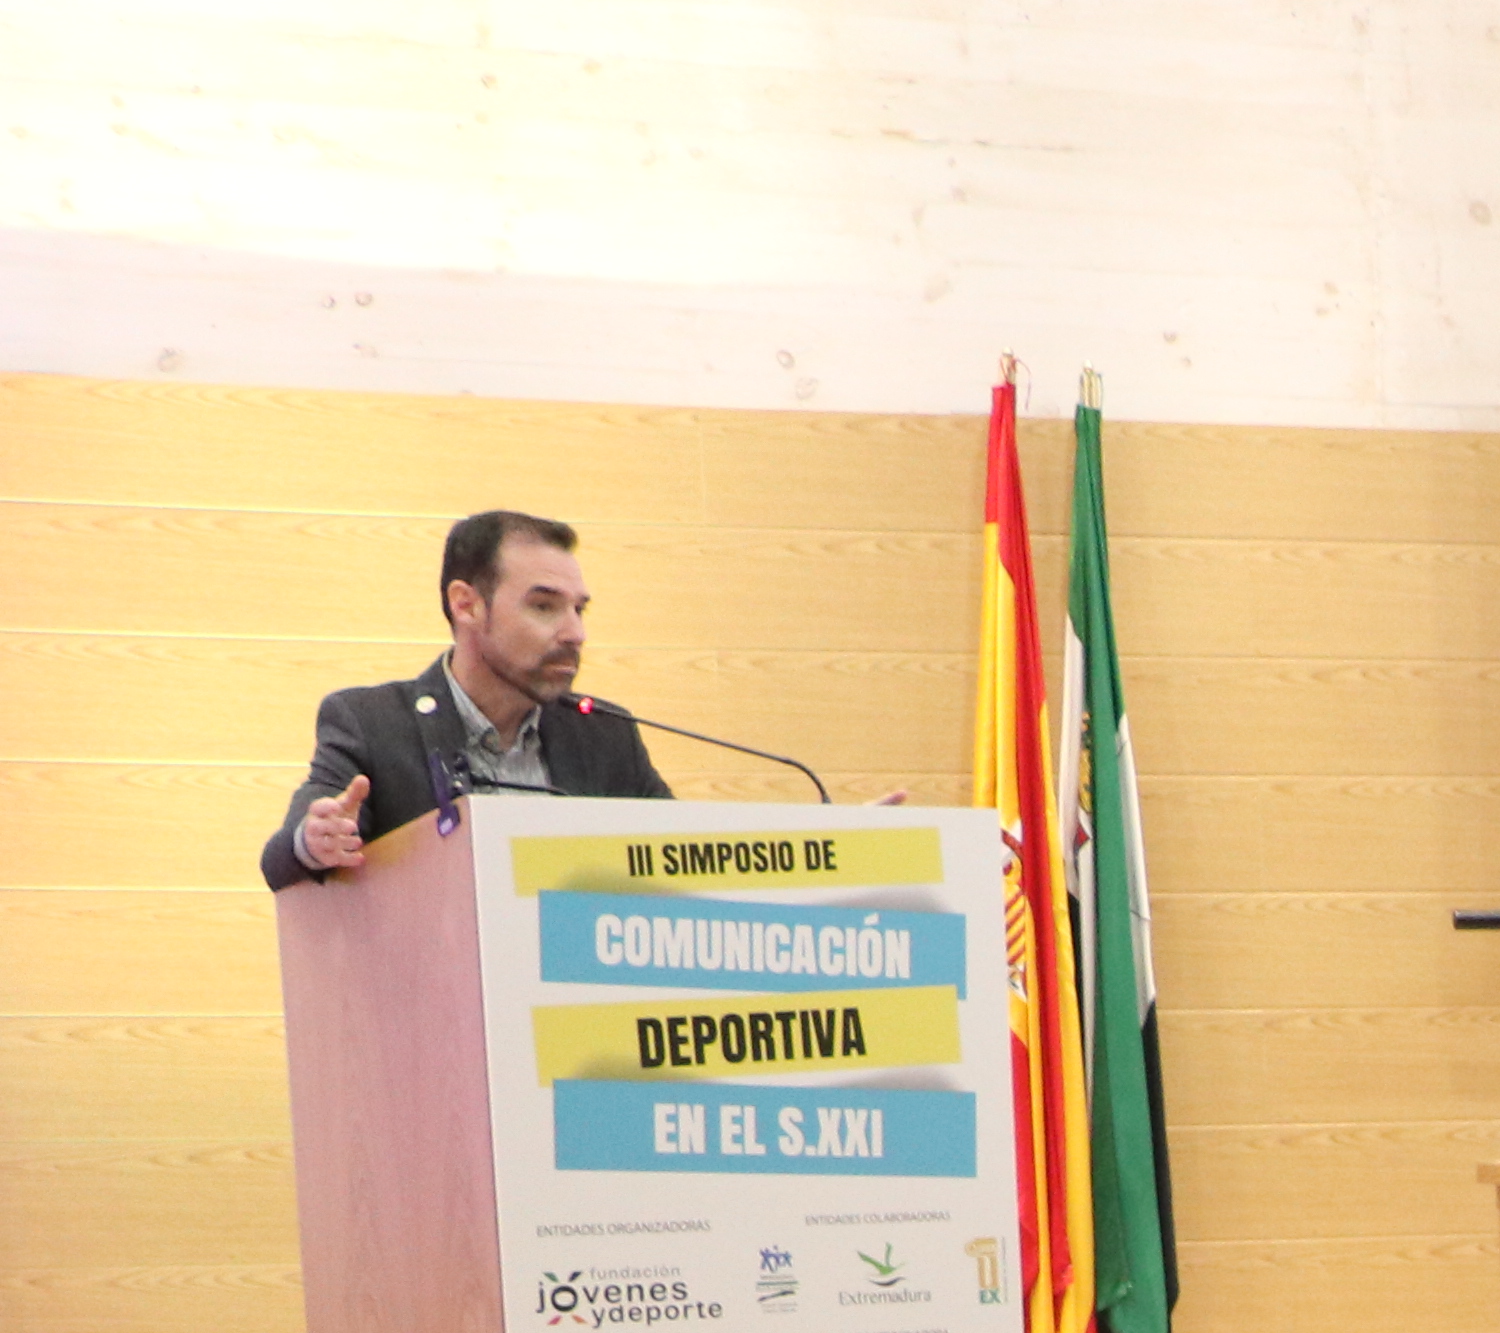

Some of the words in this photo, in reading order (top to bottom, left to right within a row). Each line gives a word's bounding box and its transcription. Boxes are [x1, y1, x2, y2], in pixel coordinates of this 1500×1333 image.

[627, 844, 654, 877] III
[662, 840, 795, 875] SIMPOSIO
[804, 840, 838, 872] DE
[595, 912, 912, 979] COMUNICACIÓN
[637, 1007, 867, 1069] DEPORTIVA
[653, 1102, 705, 1155] EN
[720, 1104, 765, 1156] EL
[778, 1107, 884, 1158] S.XXI
[591, 1301, 723, 1329] ydeporte
[838, 1287, 932, 1306] Extremadura
